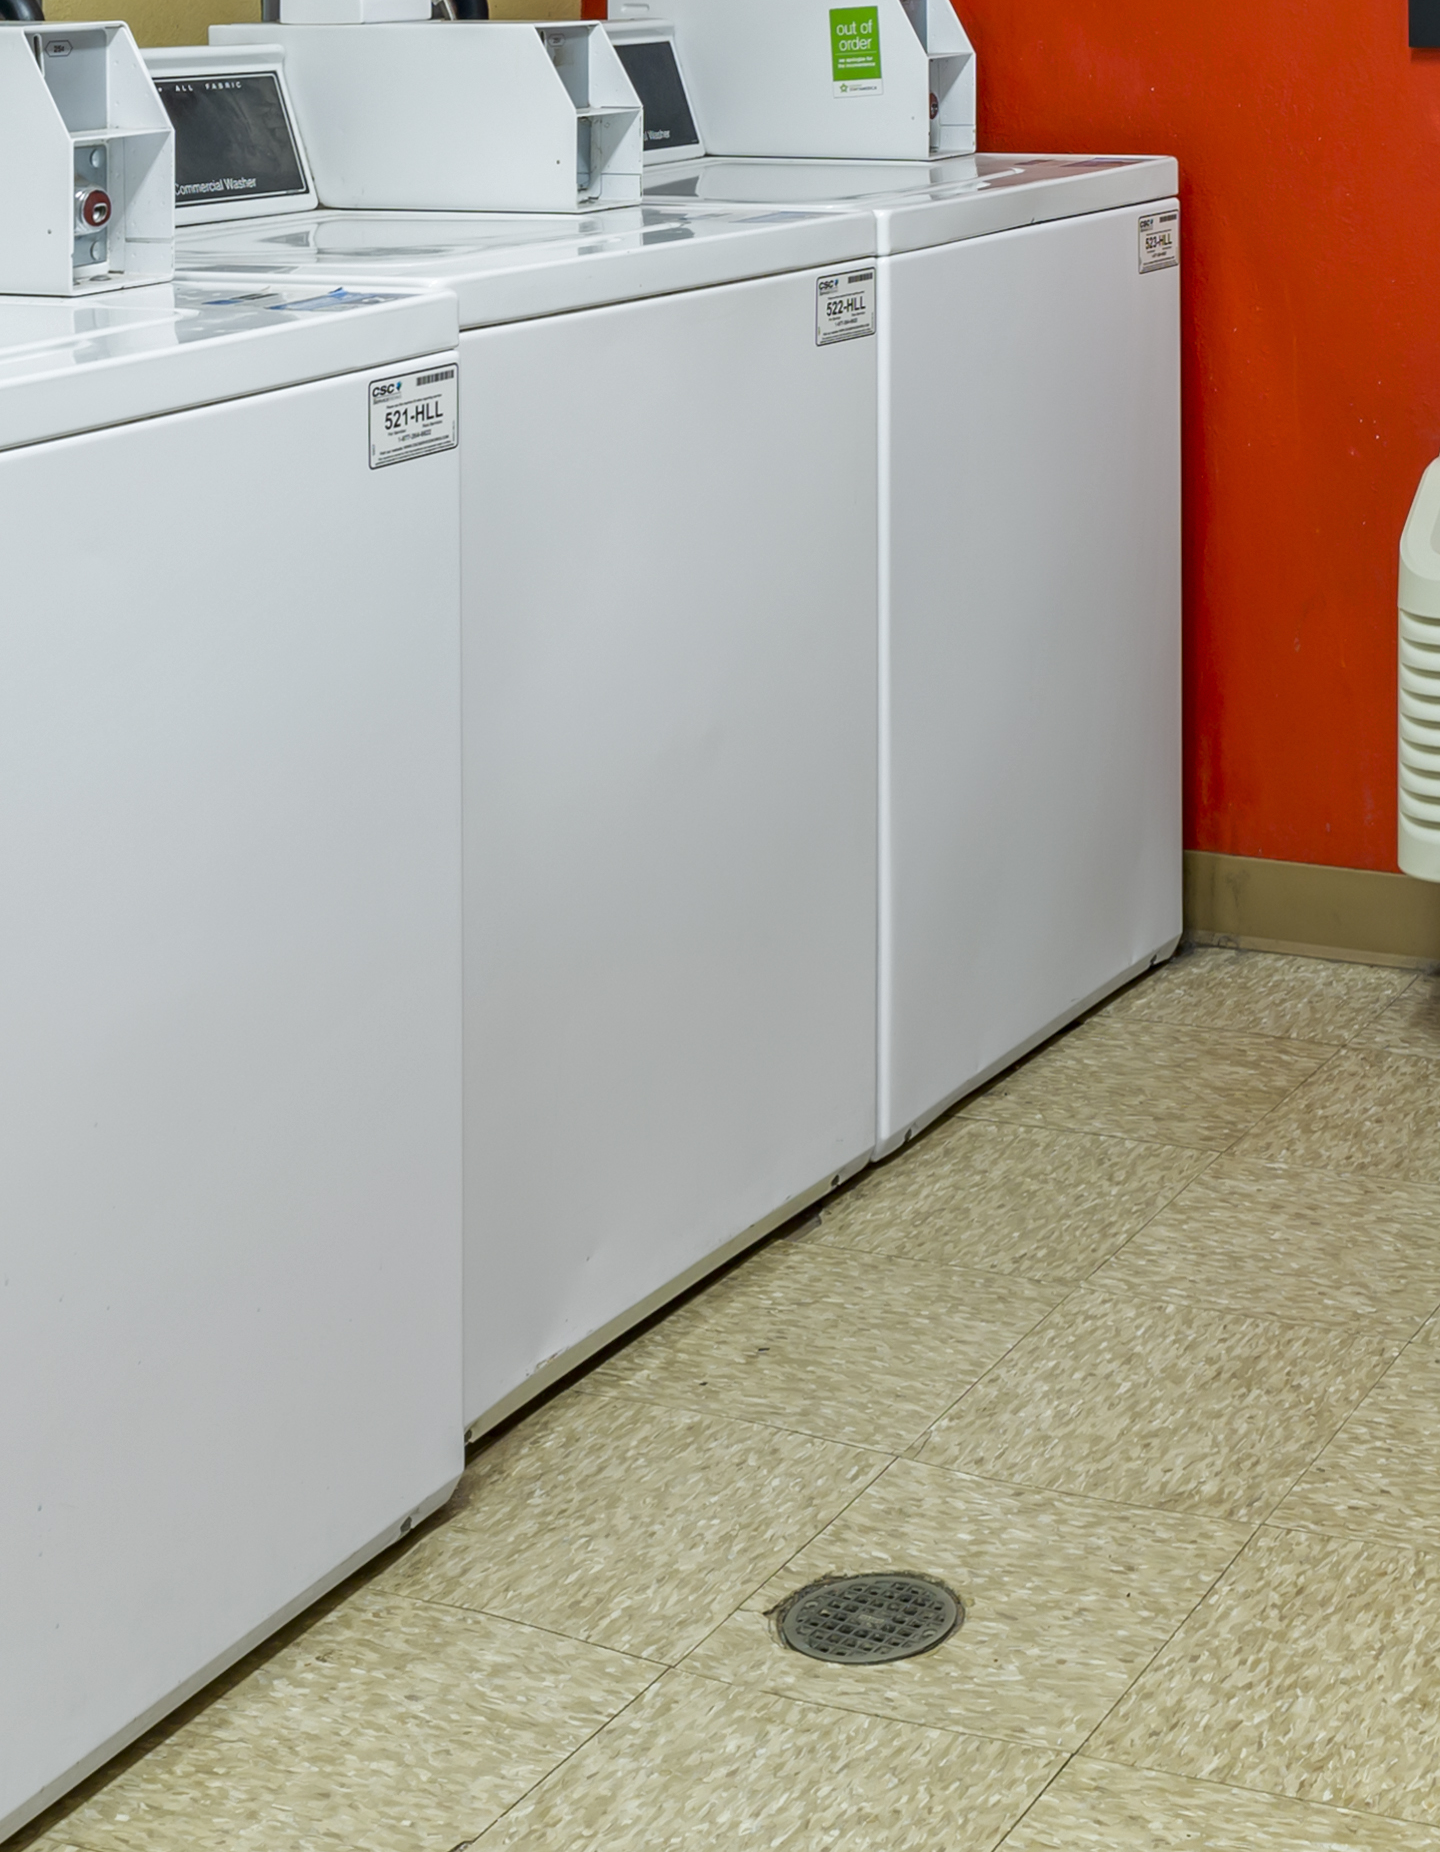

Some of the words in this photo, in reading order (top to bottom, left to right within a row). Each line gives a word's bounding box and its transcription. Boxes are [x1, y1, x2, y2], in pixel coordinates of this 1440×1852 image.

[836, 20, 857, 36] out
[860, 19, 873, 34] of
[838, 36, 872, 52] order
[175, 84, 194, 92] ALL
[205, 81, 242, 90] FABRIC
[223, 177, 257, 190] Washer
[826, 295, 866, 317] 522-HLL
[372, 383, 395, 398] CSC
[384, 400, 444, 431] 521-HLL
